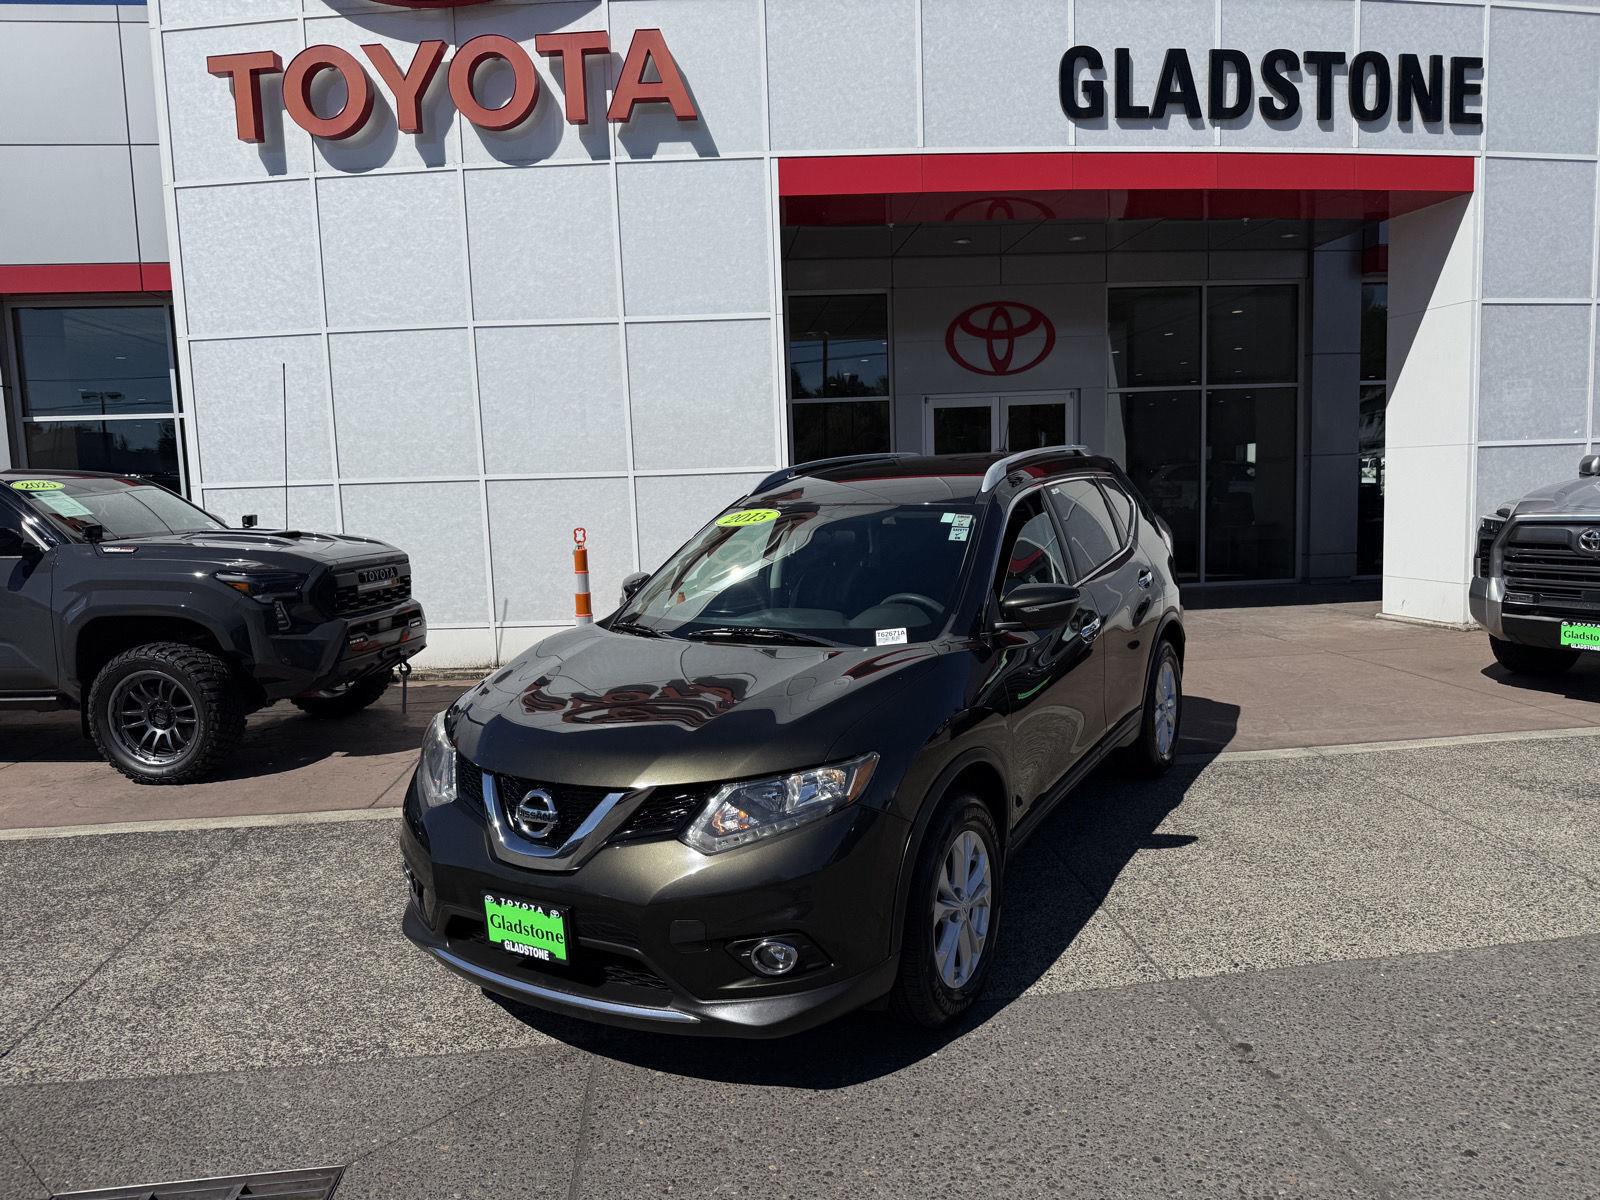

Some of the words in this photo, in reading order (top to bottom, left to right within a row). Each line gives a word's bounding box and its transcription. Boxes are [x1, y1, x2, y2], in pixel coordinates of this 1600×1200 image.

[207, 28, 698, 144] TOYOTA
[1059, 45, 1484, 125] GLADSTONE
[723, 511, 773, 524] 2015
[363, 568, 396, 582] TOYOTA
[519, 808, 556, 822] NISSAN
[500, 898, 543, 914] TOYOTA
[490, 913, 564, 944] Gladstone
[504, 940, 549, 960] GLADSTONE
